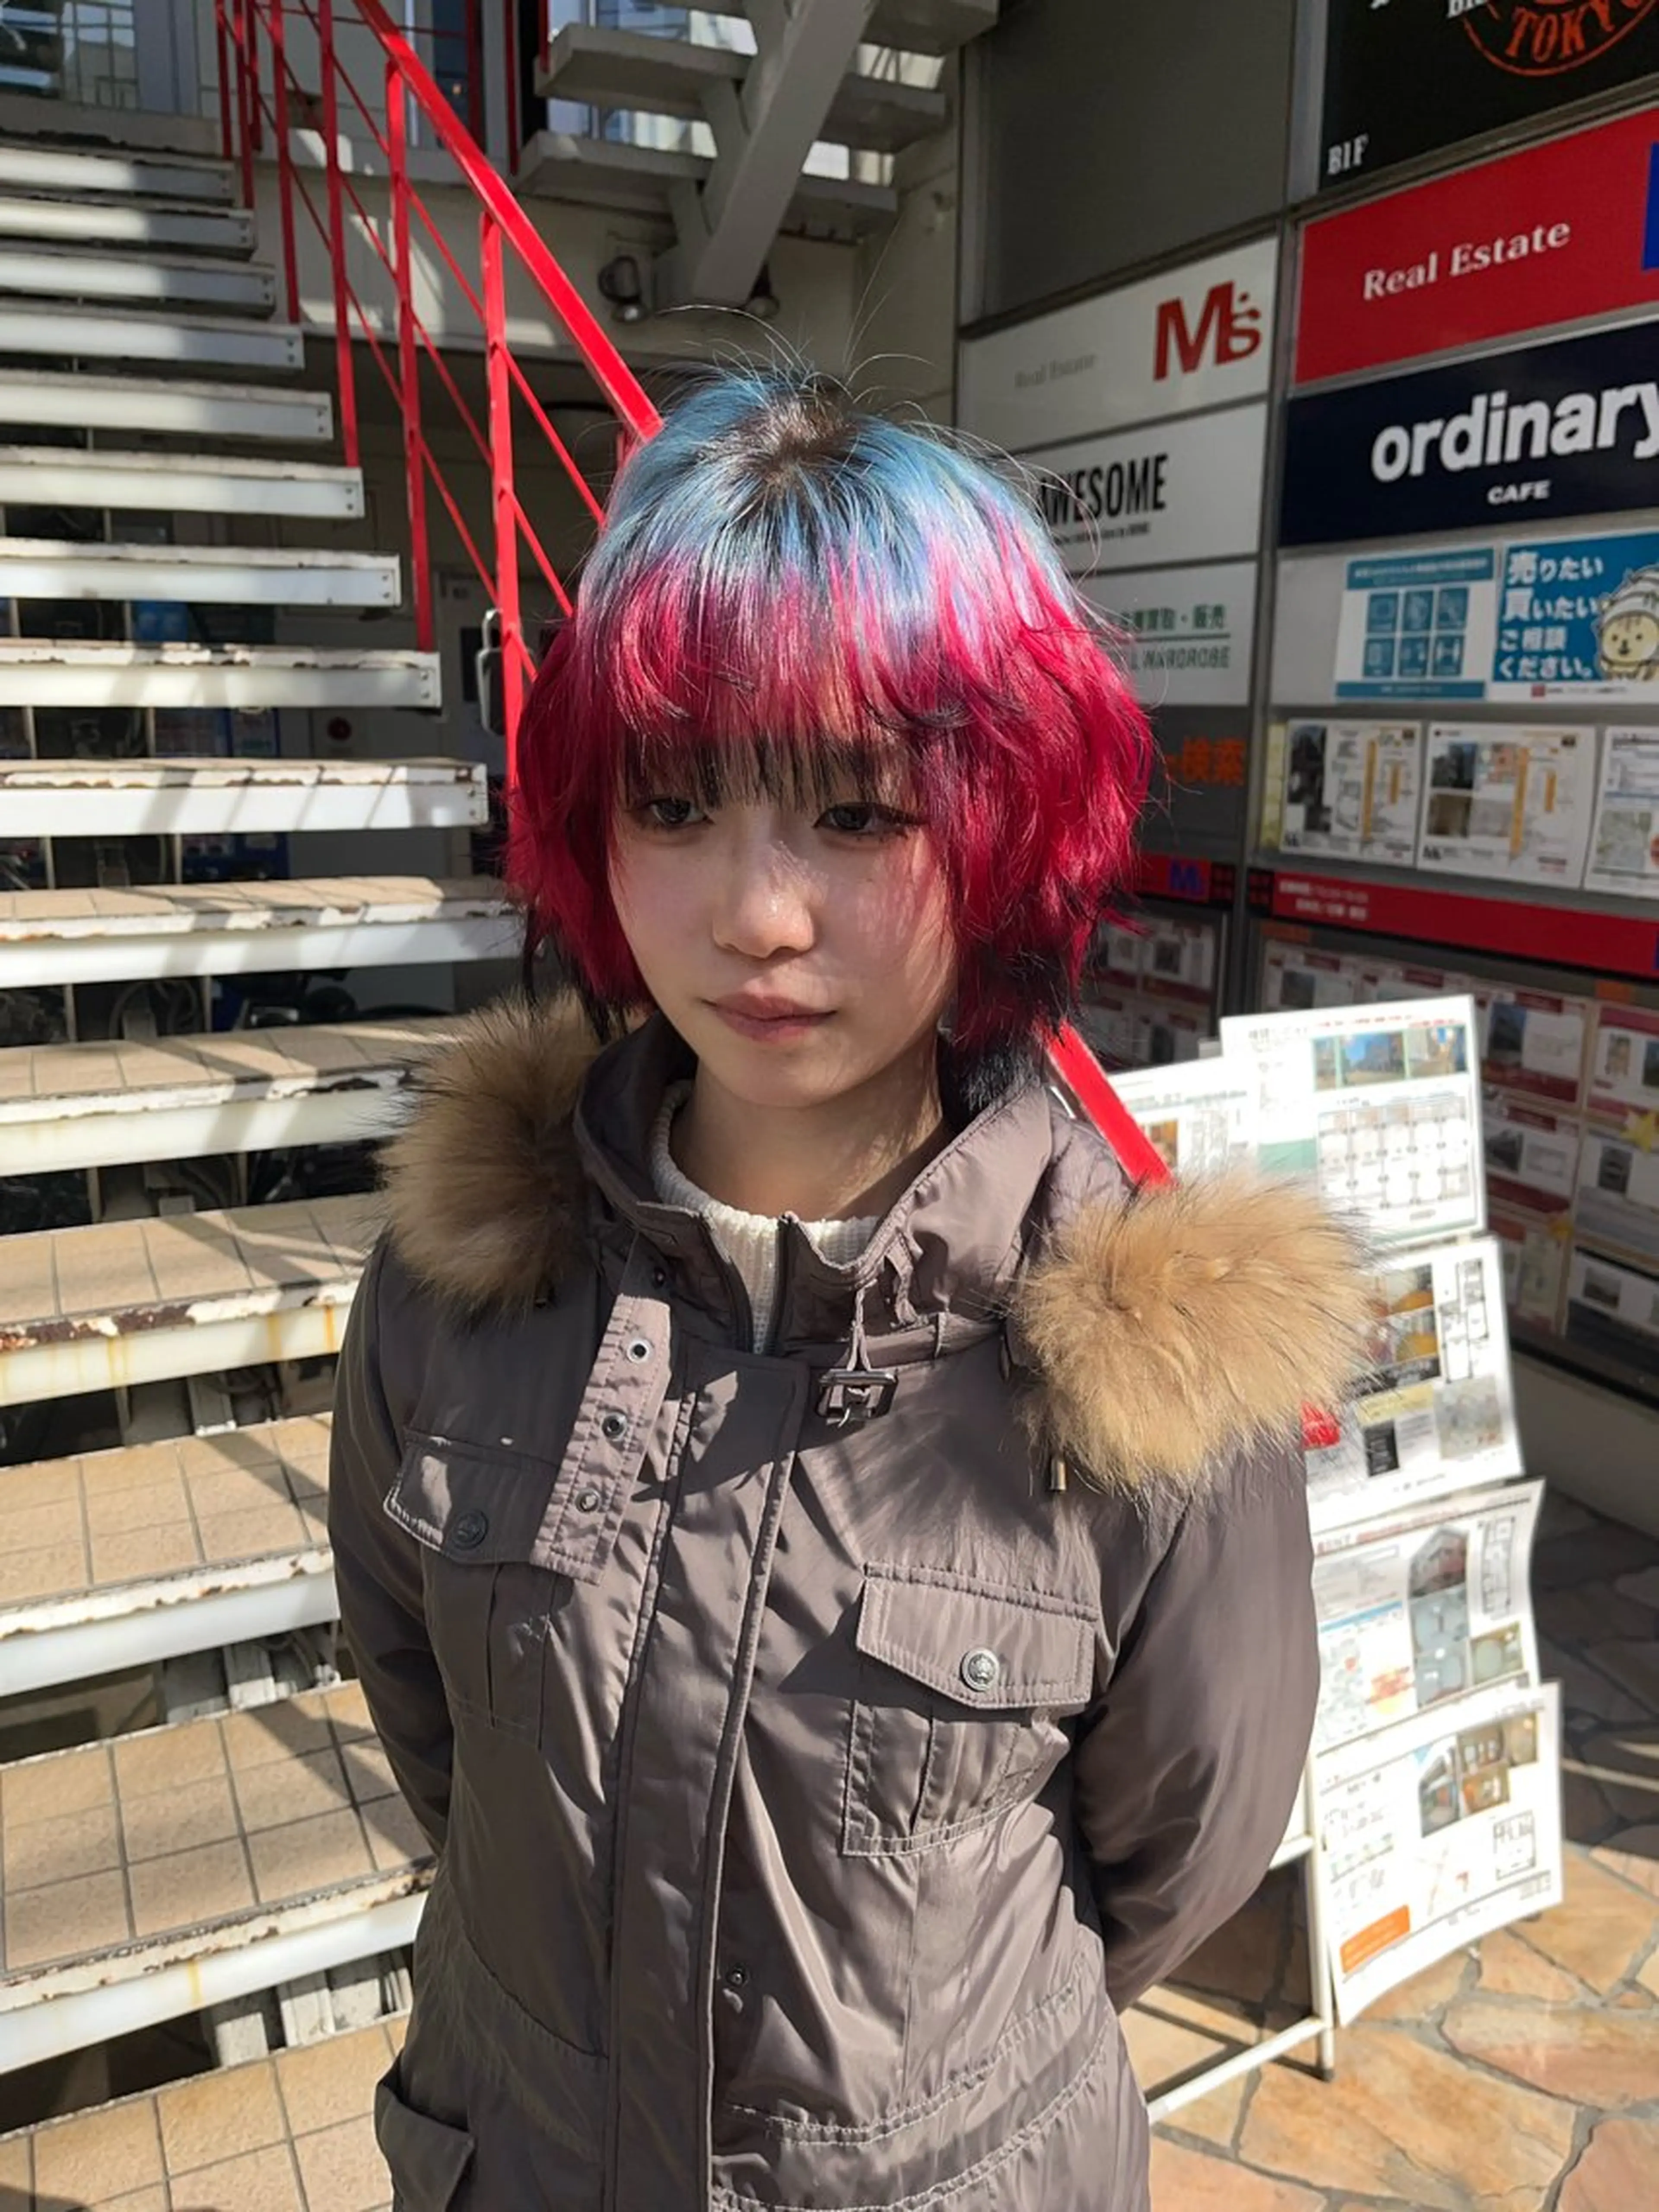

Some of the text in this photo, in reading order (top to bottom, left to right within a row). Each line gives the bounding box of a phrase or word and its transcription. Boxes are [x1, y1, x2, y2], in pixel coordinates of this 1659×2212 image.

[1505, 0, 1642, 63] TOKY
[1328, 134, 1368, 174] BIF
[1363, 222, 1571, 301] Real Estate
[1371, 382, 1659, 482] ordinary
[1487, 480, 1550, 504] CAFE
[1507, 550, 1603, 585] 売りたい
[1501, 587, 1599, 623] 買いたい
